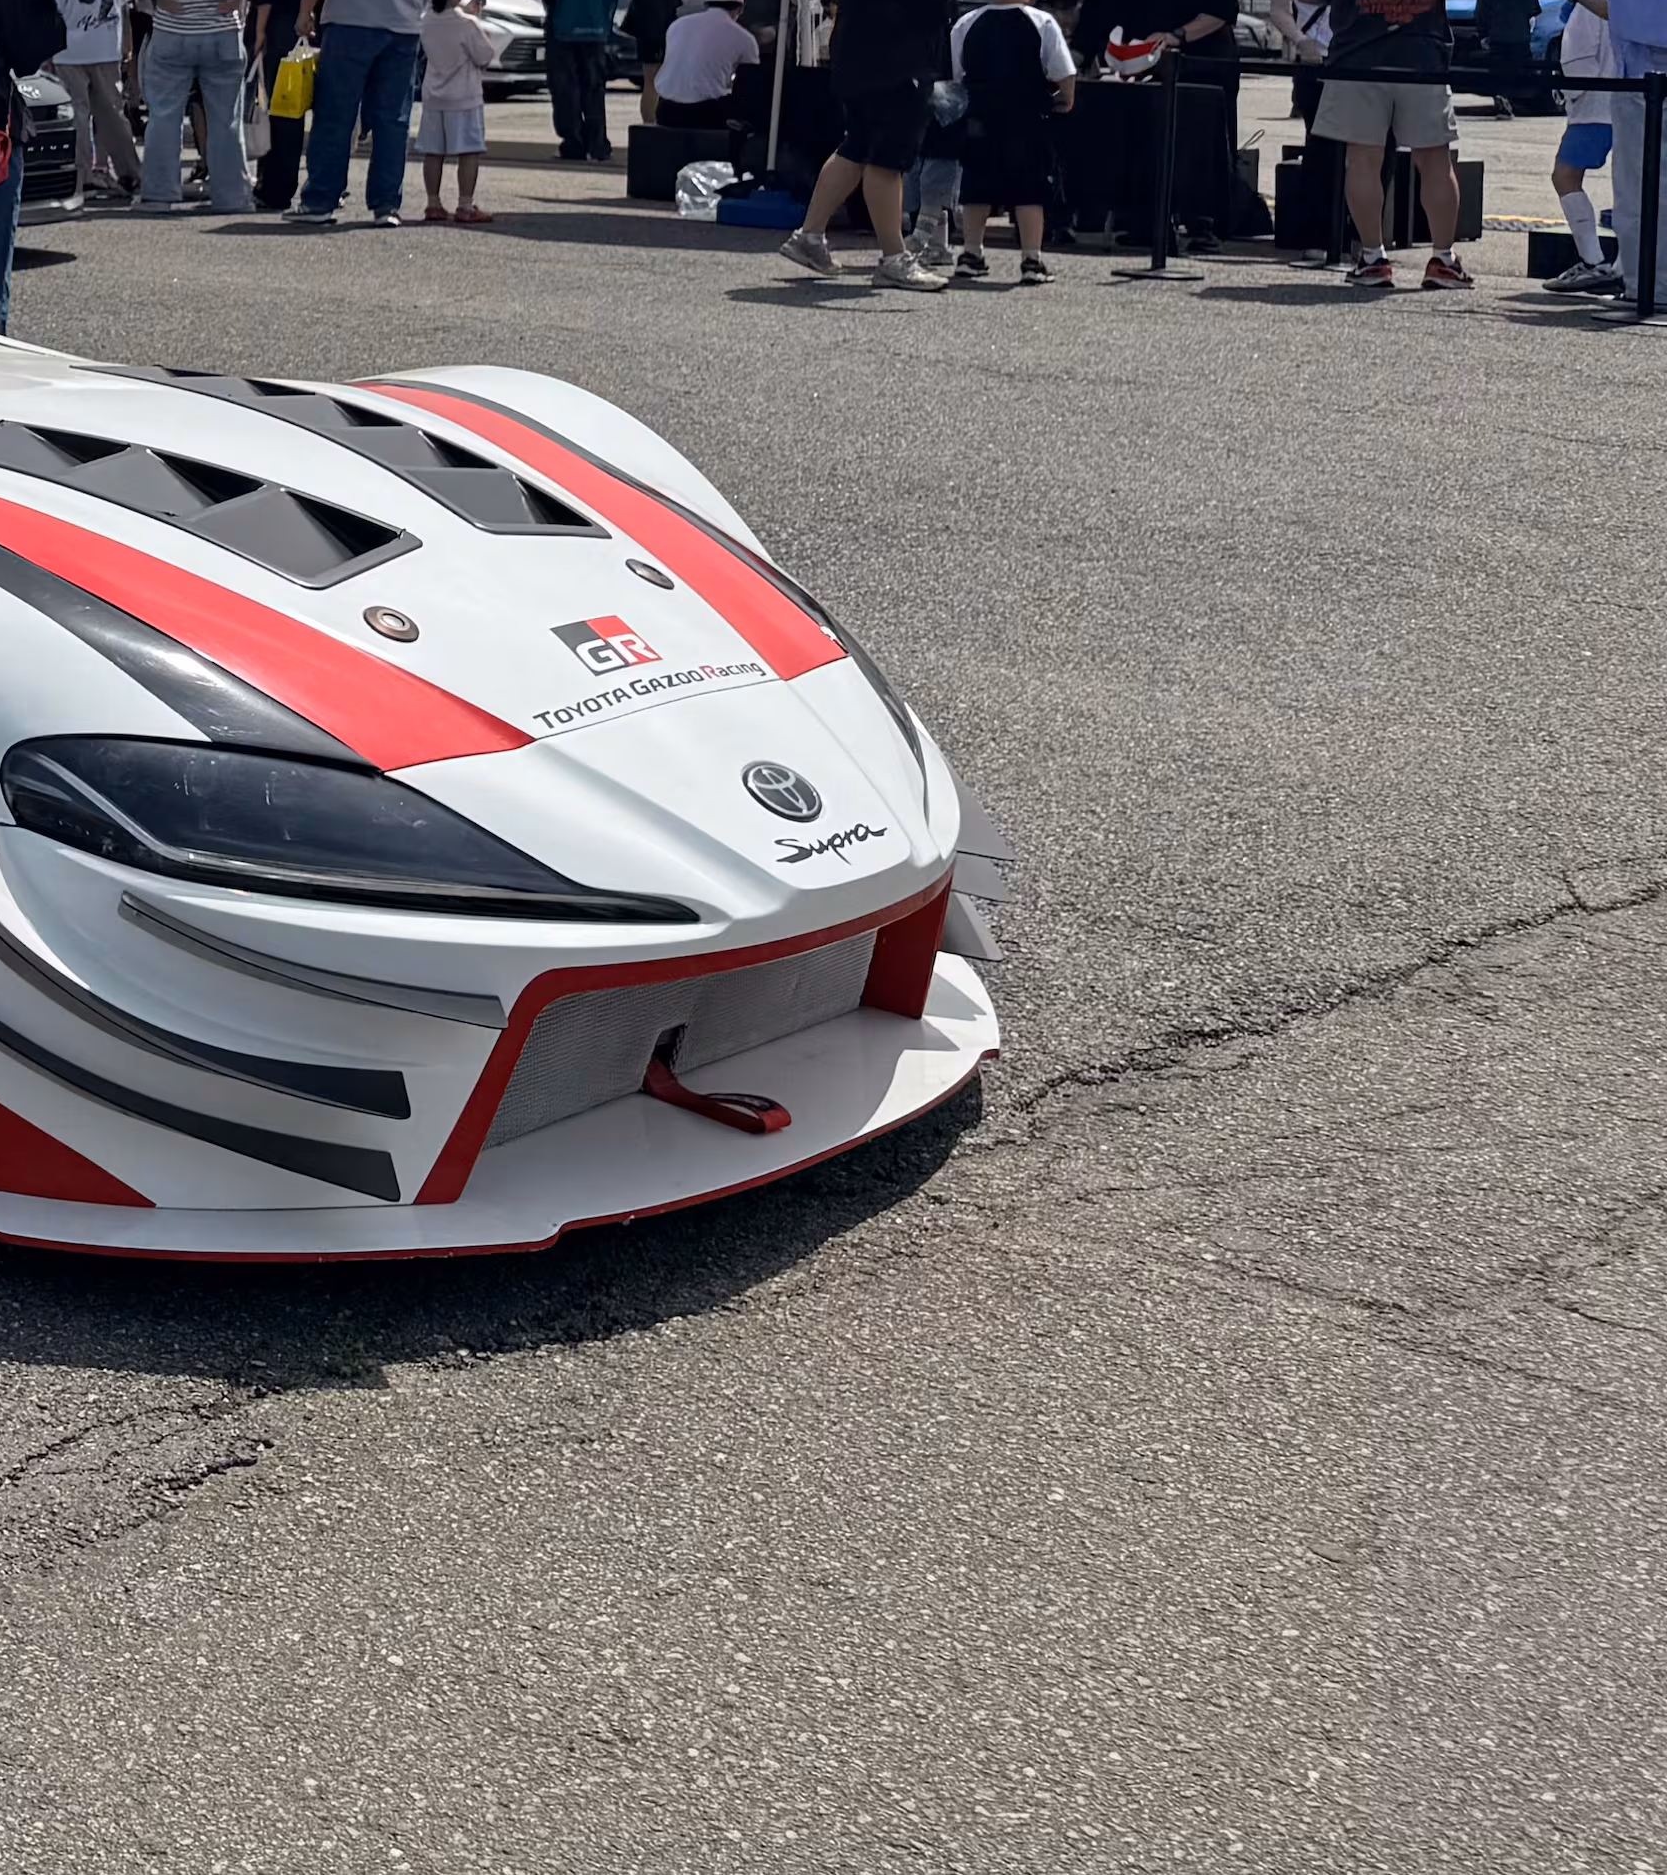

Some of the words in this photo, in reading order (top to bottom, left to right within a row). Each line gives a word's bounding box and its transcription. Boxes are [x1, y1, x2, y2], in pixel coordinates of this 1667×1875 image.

[575, 632, 659, 674] GR
[532, 687, 633, 730] TOYOTA
[629, 670, 706, 697] GAZOO
[699, 662, 767, 679] Racing
[774, 823, 888, 866] Supra
